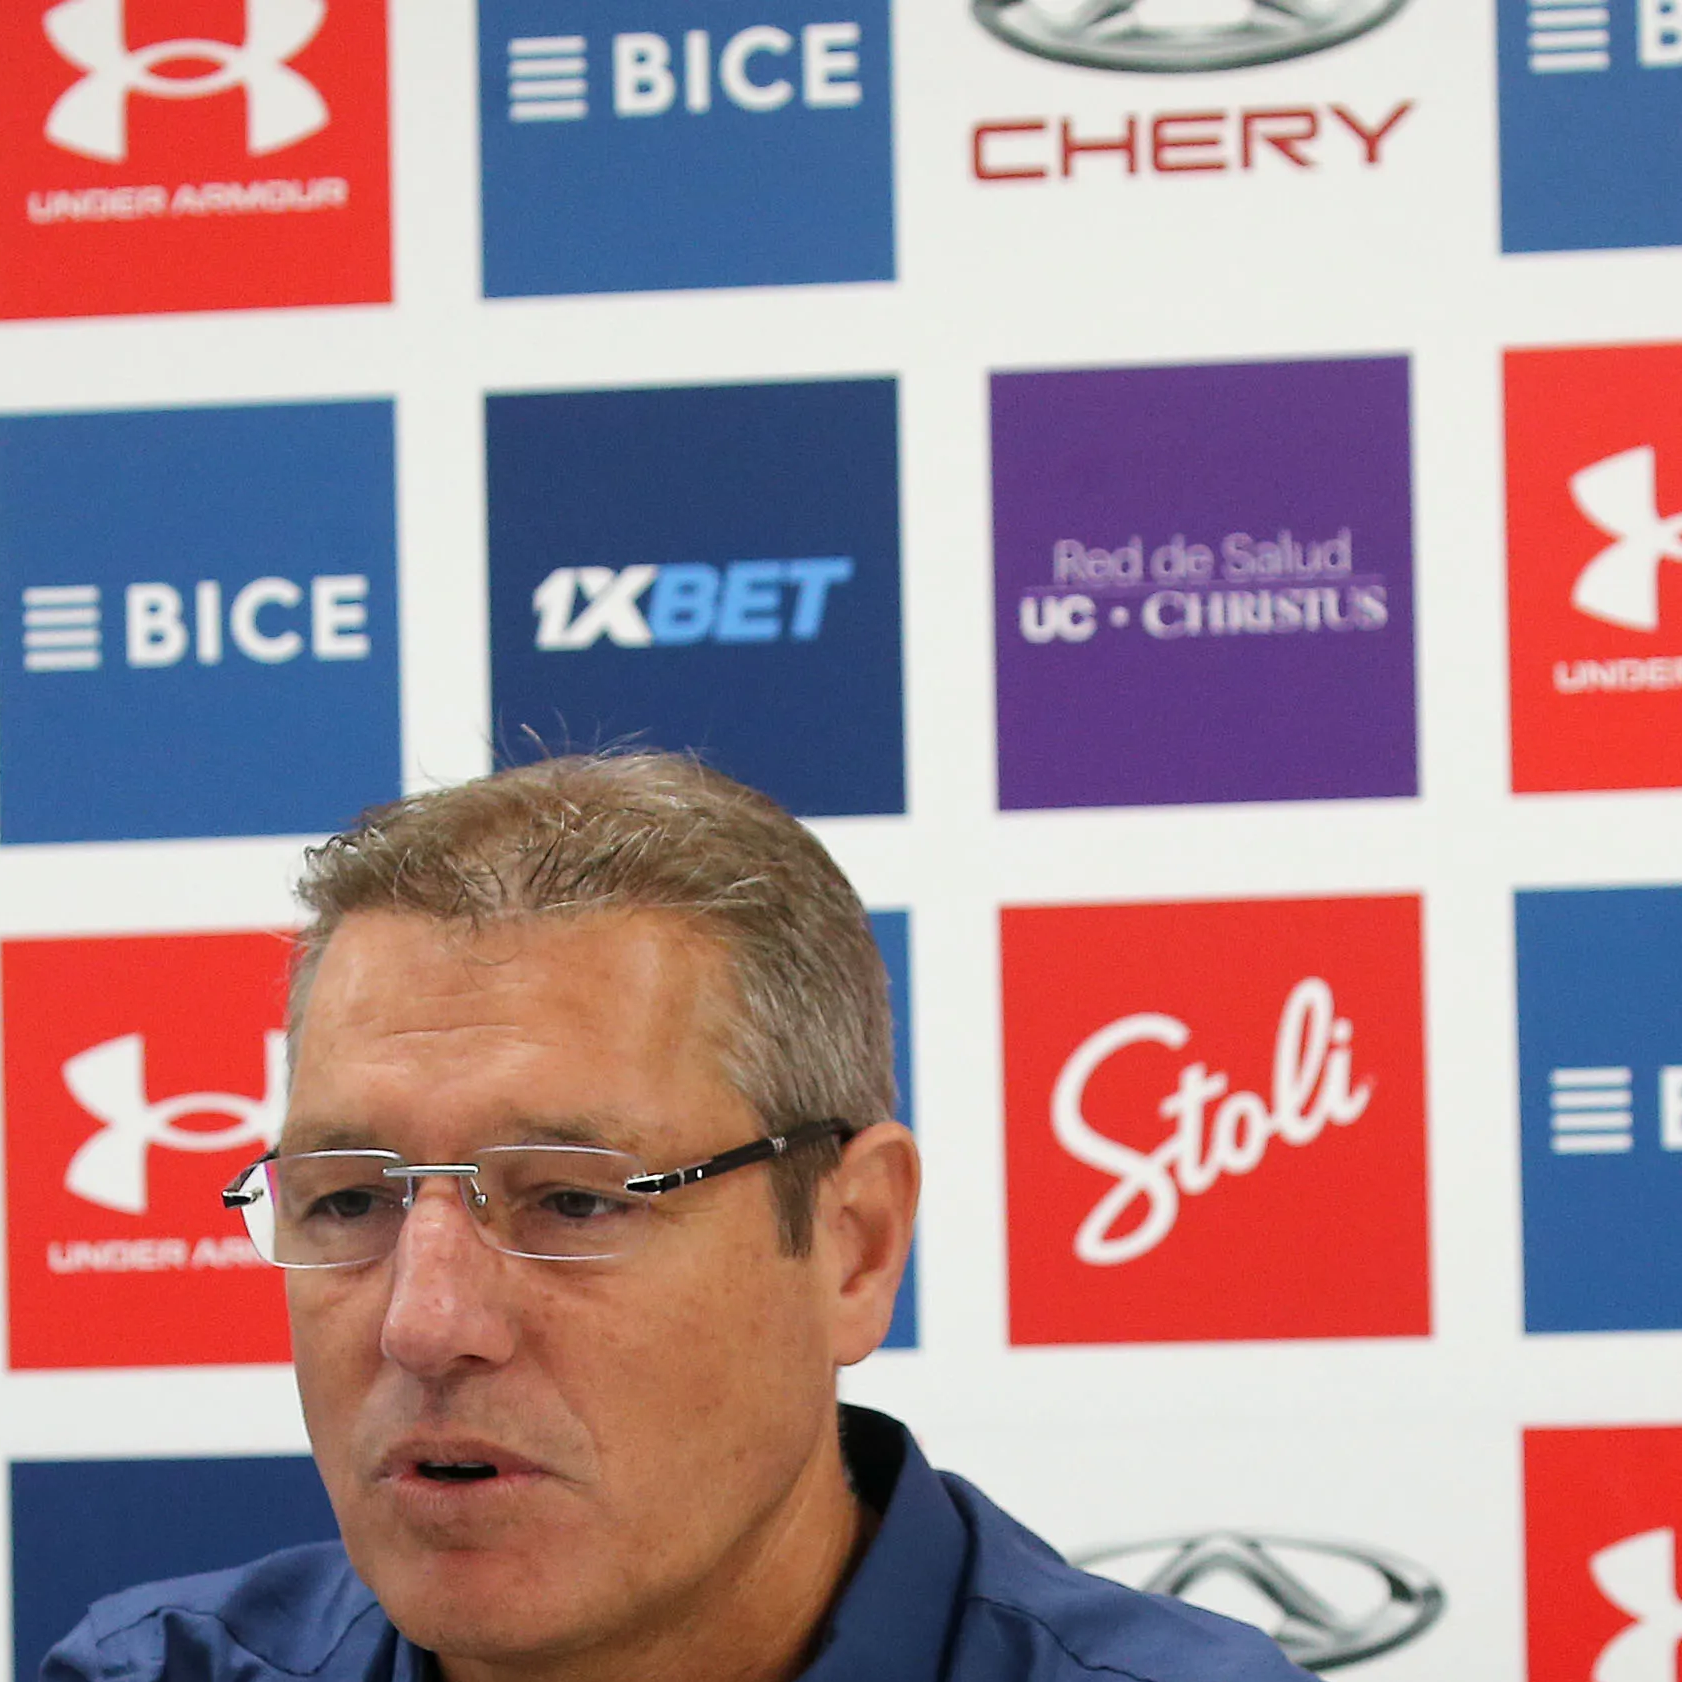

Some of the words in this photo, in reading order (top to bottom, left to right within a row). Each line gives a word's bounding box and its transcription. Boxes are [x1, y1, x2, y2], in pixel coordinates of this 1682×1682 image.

[613, 23, 862, 117] BICE
[971, 103, 1410, 182] CHERY
[27, 185, 169, 223] UNDER
[169, 177, 348, 214] ARMOUR
[1053, 536, 1143, 587] Red
[1151, 533, 1214, 584] de
[1224, 528, 1353, 577] Salud
[126, 575, 370, 668] BICE
[532, 559, 851, 652] 1XBET
[1020, 594, 1095, 643] UC
[1142, 584, 1387, 637] CHRISTUS
[1051, 977, 1371, 1265] Stoli
[48, 1239, 190, 1273] UNDER
